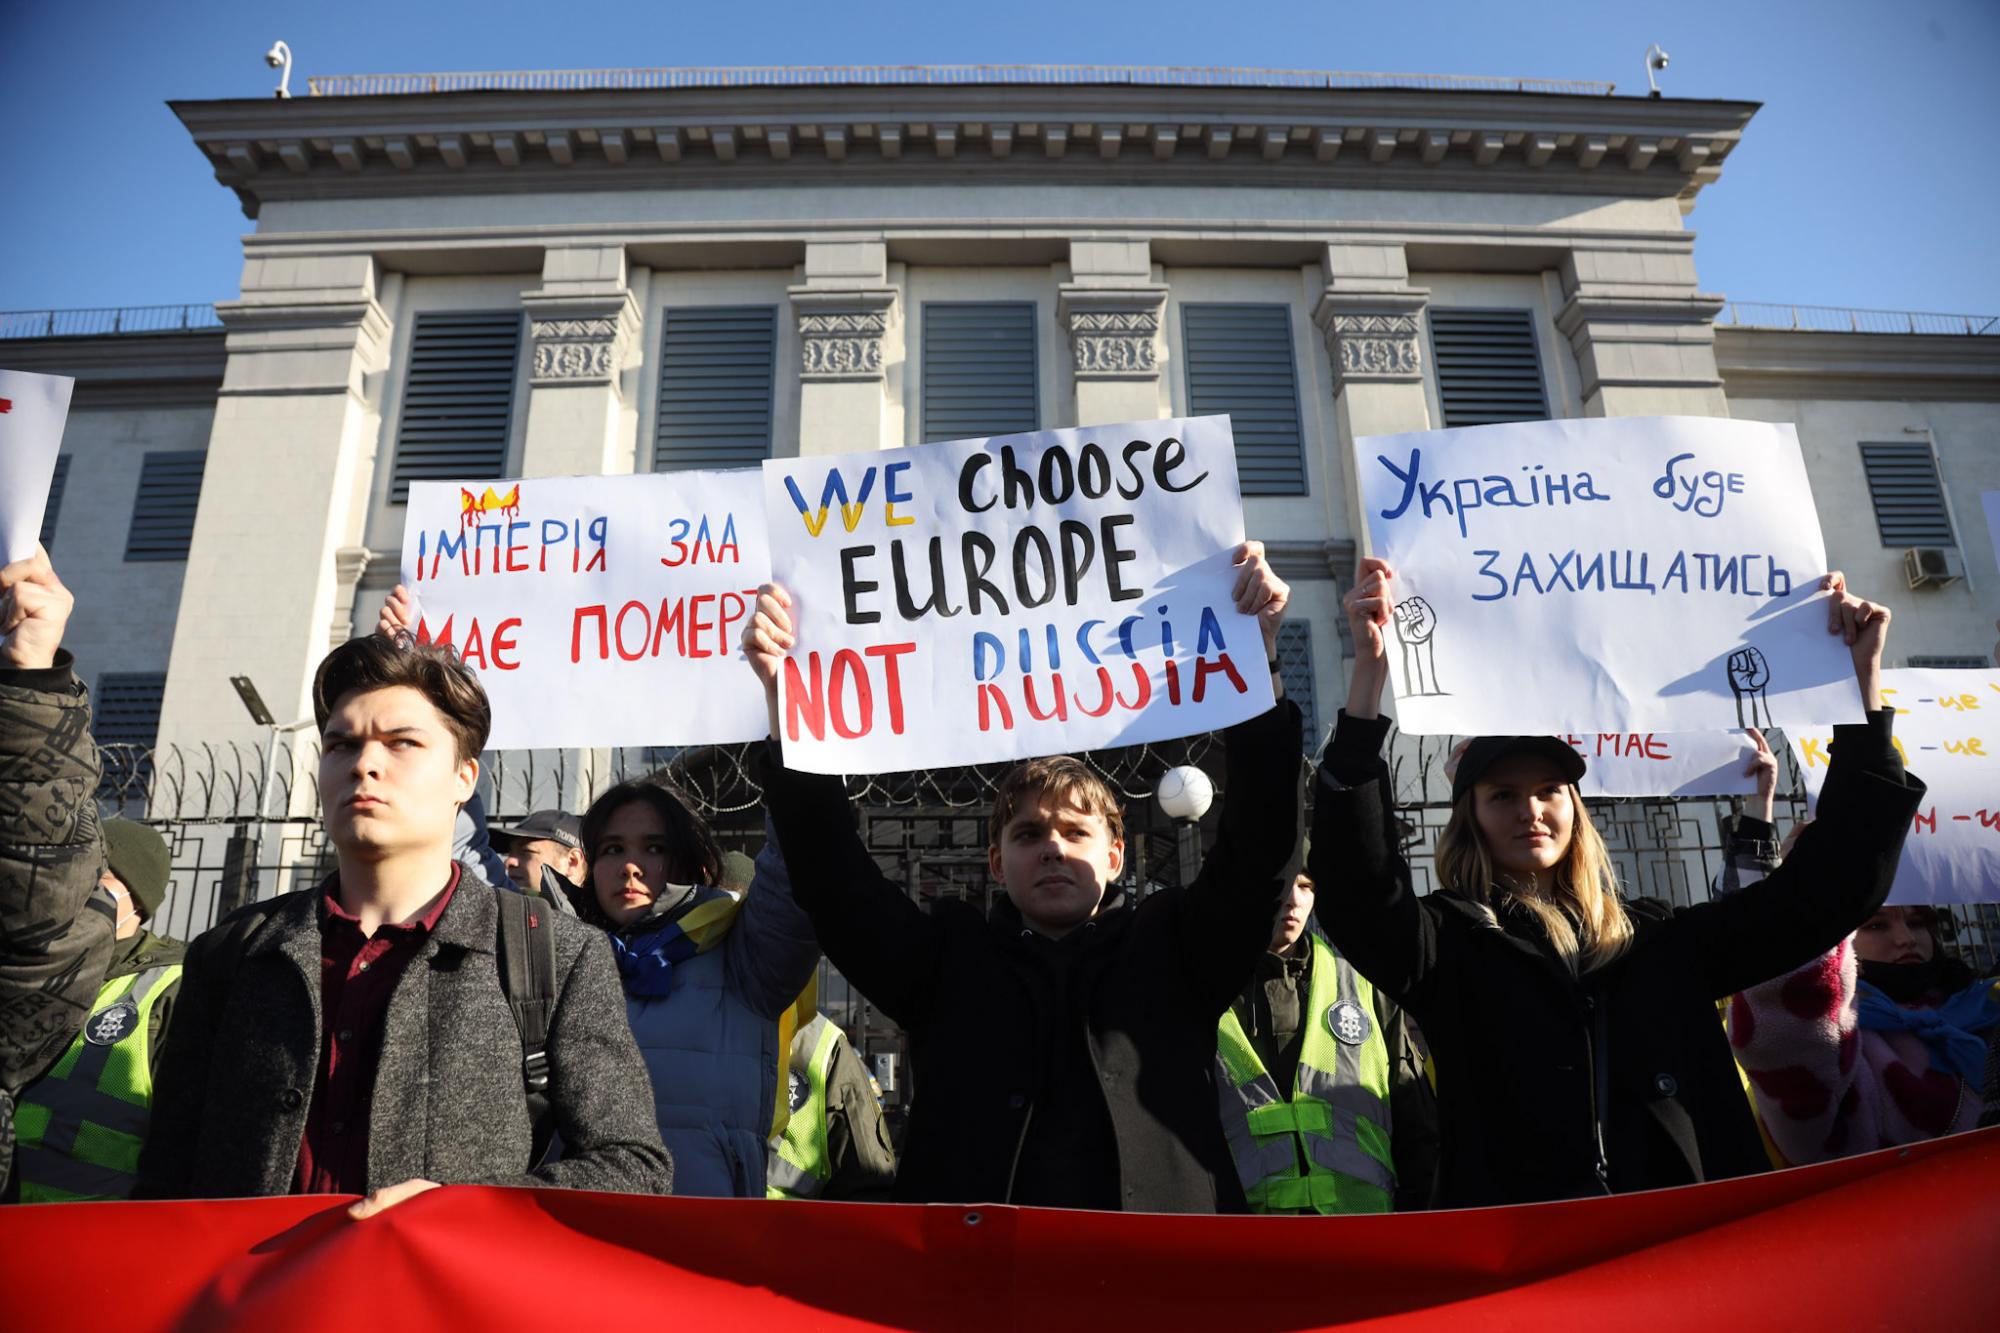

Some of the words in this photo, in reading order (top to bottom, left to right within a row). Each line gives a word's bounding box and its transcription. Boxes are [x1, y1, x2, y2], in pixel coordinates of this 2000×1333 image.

[784, 460, 916, 538] WE
[1377, 448, 1610, 538] Україна
[417, 515, 608, 581] ІМПЕРІЯ
[660, 512, 740, 567] ЗЛА
[840, 514, 1144, 625] EUROPE
[1472, 549, 1791, 601] ЗАХИЩАТИСЬ
[784, 641, 917, 742] NOT
